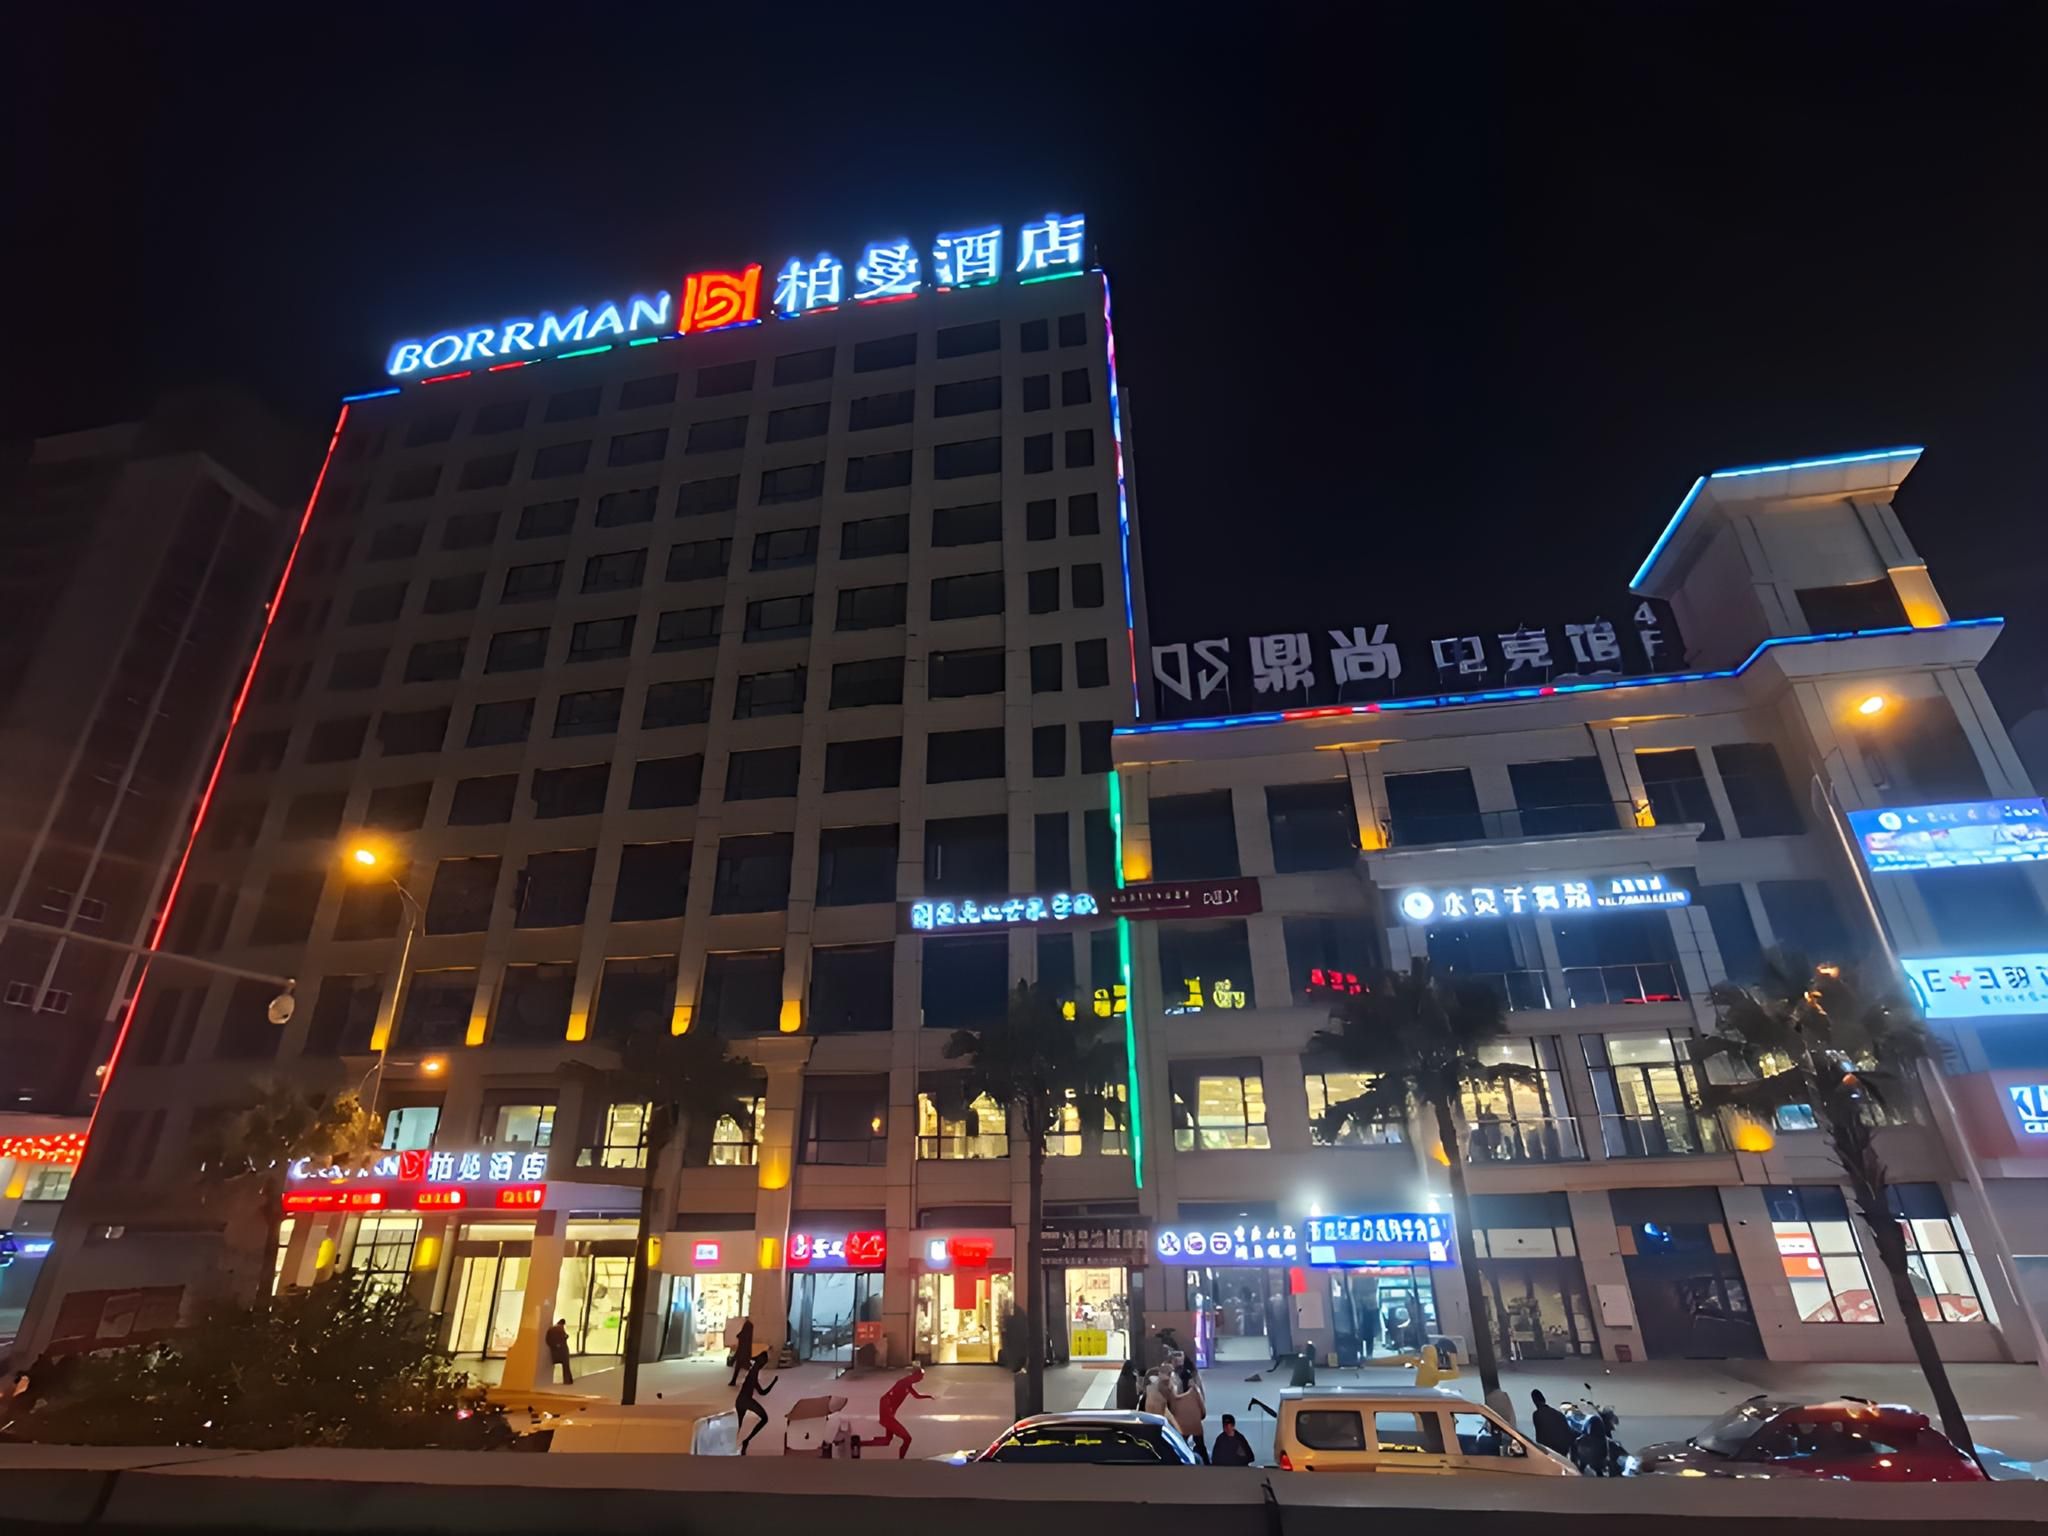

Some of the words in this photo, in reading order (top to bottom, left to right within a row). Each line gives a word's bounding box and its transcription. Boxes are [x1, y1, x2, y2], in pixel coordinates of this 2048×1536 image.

[774, 213, 1086, 314] 柏曼酒店
[387, 291, 671, 376] BORRMAN
